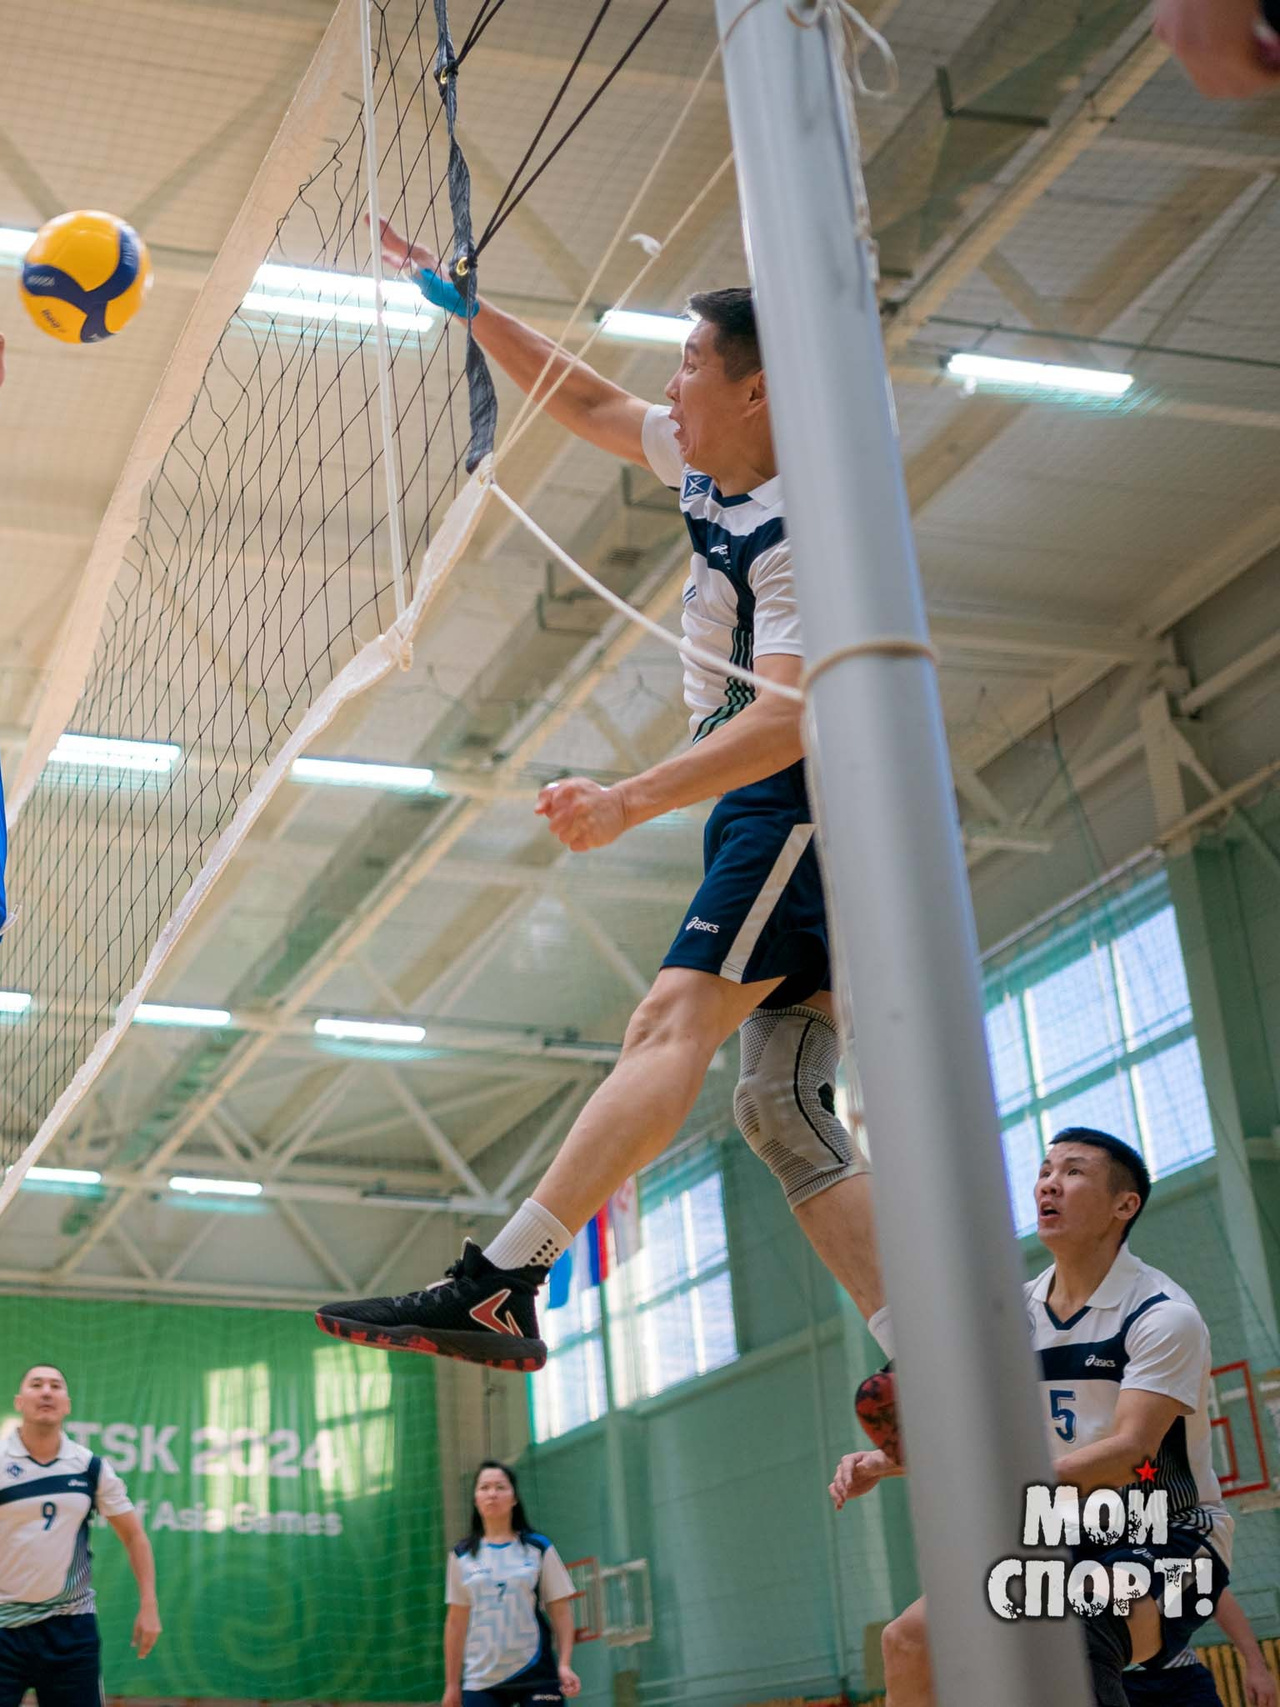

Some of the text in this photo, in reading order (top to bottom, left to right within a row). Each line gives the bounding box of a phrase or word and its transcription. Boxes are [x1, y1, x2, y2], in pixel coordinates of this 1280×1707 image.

[693, 920, 720, 934] asics
[1049, 1389, 1077, 1443] 5
[192, 1427, 339, 1482] 2024
[41, 1501, 57, 1531] 9
[152, 1500, 227, 1533] Asia
[233, 1502, 343, 1537] Games
[495, 1582, 507, 1602] 7
